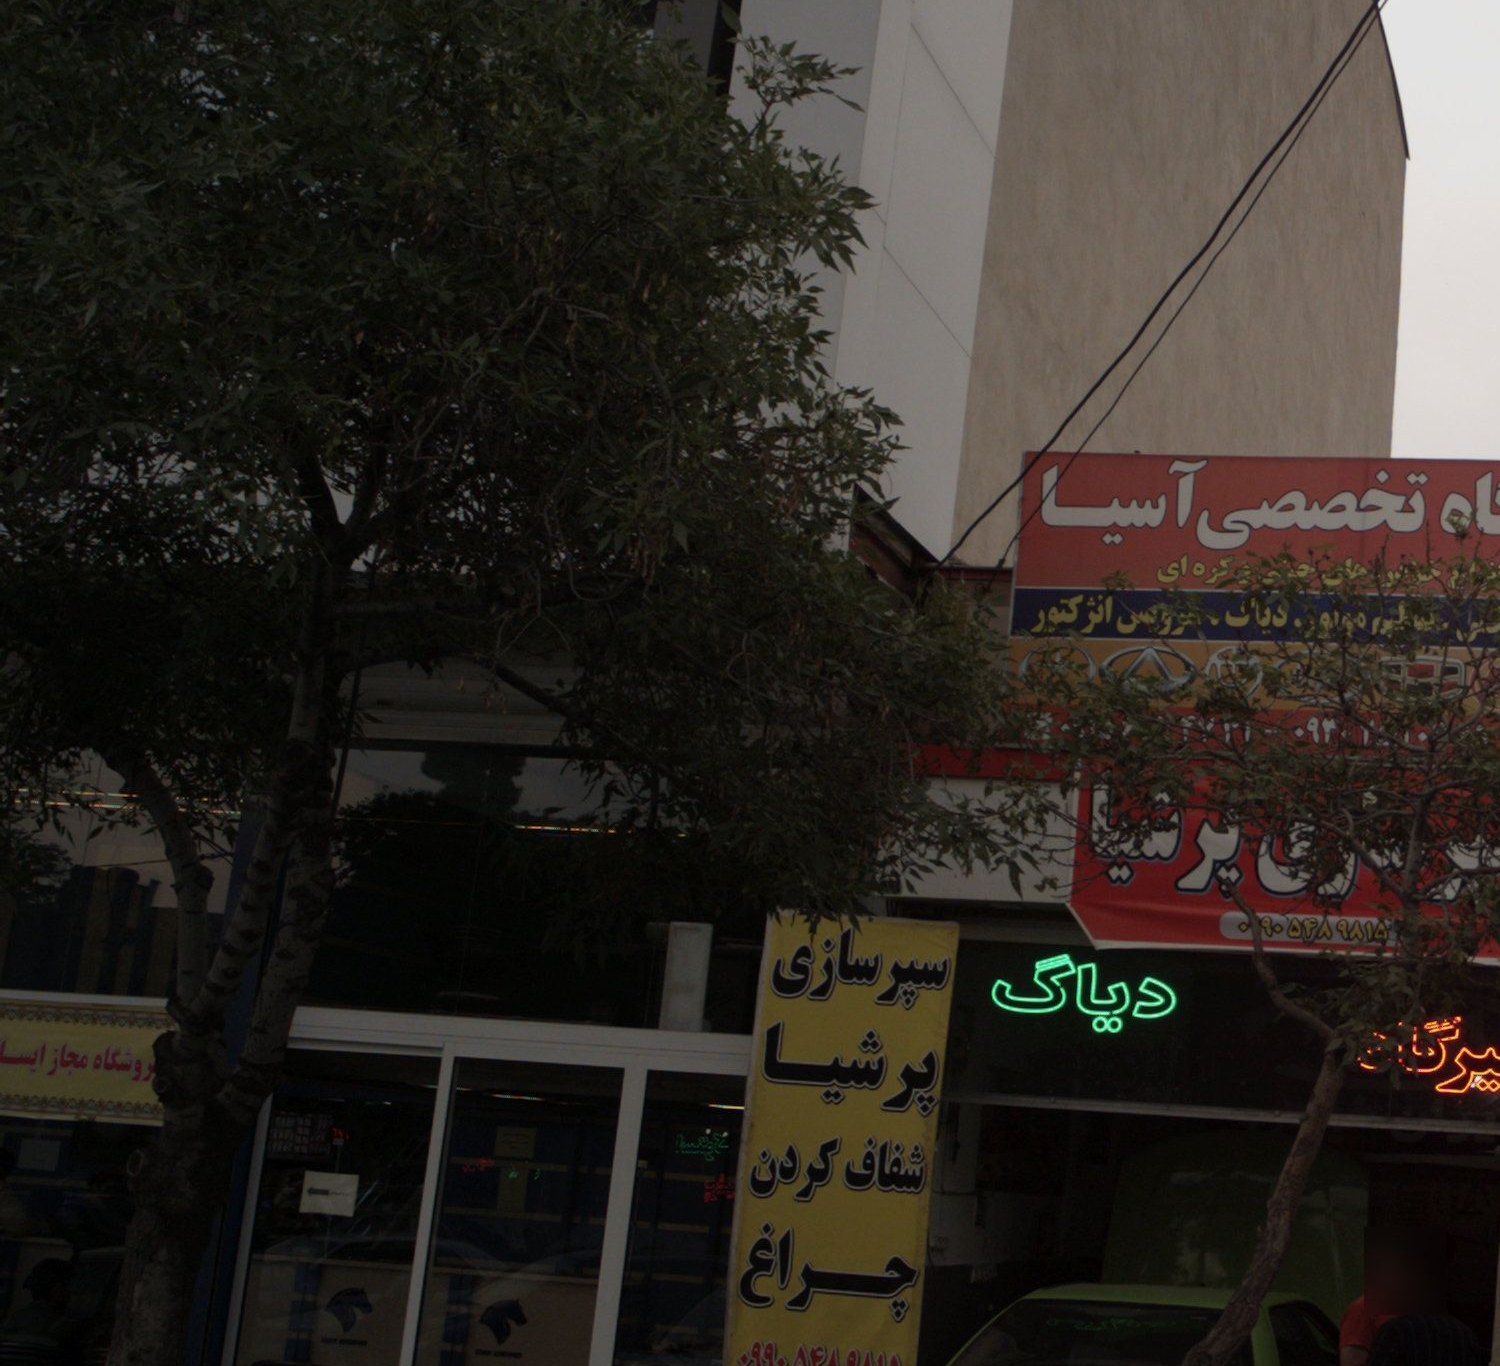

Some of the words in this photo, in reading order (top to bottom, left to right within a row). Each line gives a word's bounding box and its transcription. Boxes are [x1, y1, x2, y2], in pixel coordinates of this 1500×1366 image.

[1040, 459, 1208, 545] آسیا
[1196, 468, 1427, 551] تخصصی
[1238, 916, 1284, 938] ۰۹۰
[992, 954, 1178, 1033] دیاگ
[763, 1021, 939, 1115] پرشیا
[749, 1137, 839, 1200] کردن
[845, 1137, 926, 1196] شفاف
[738, 1223, 918, 1322] چراغ
